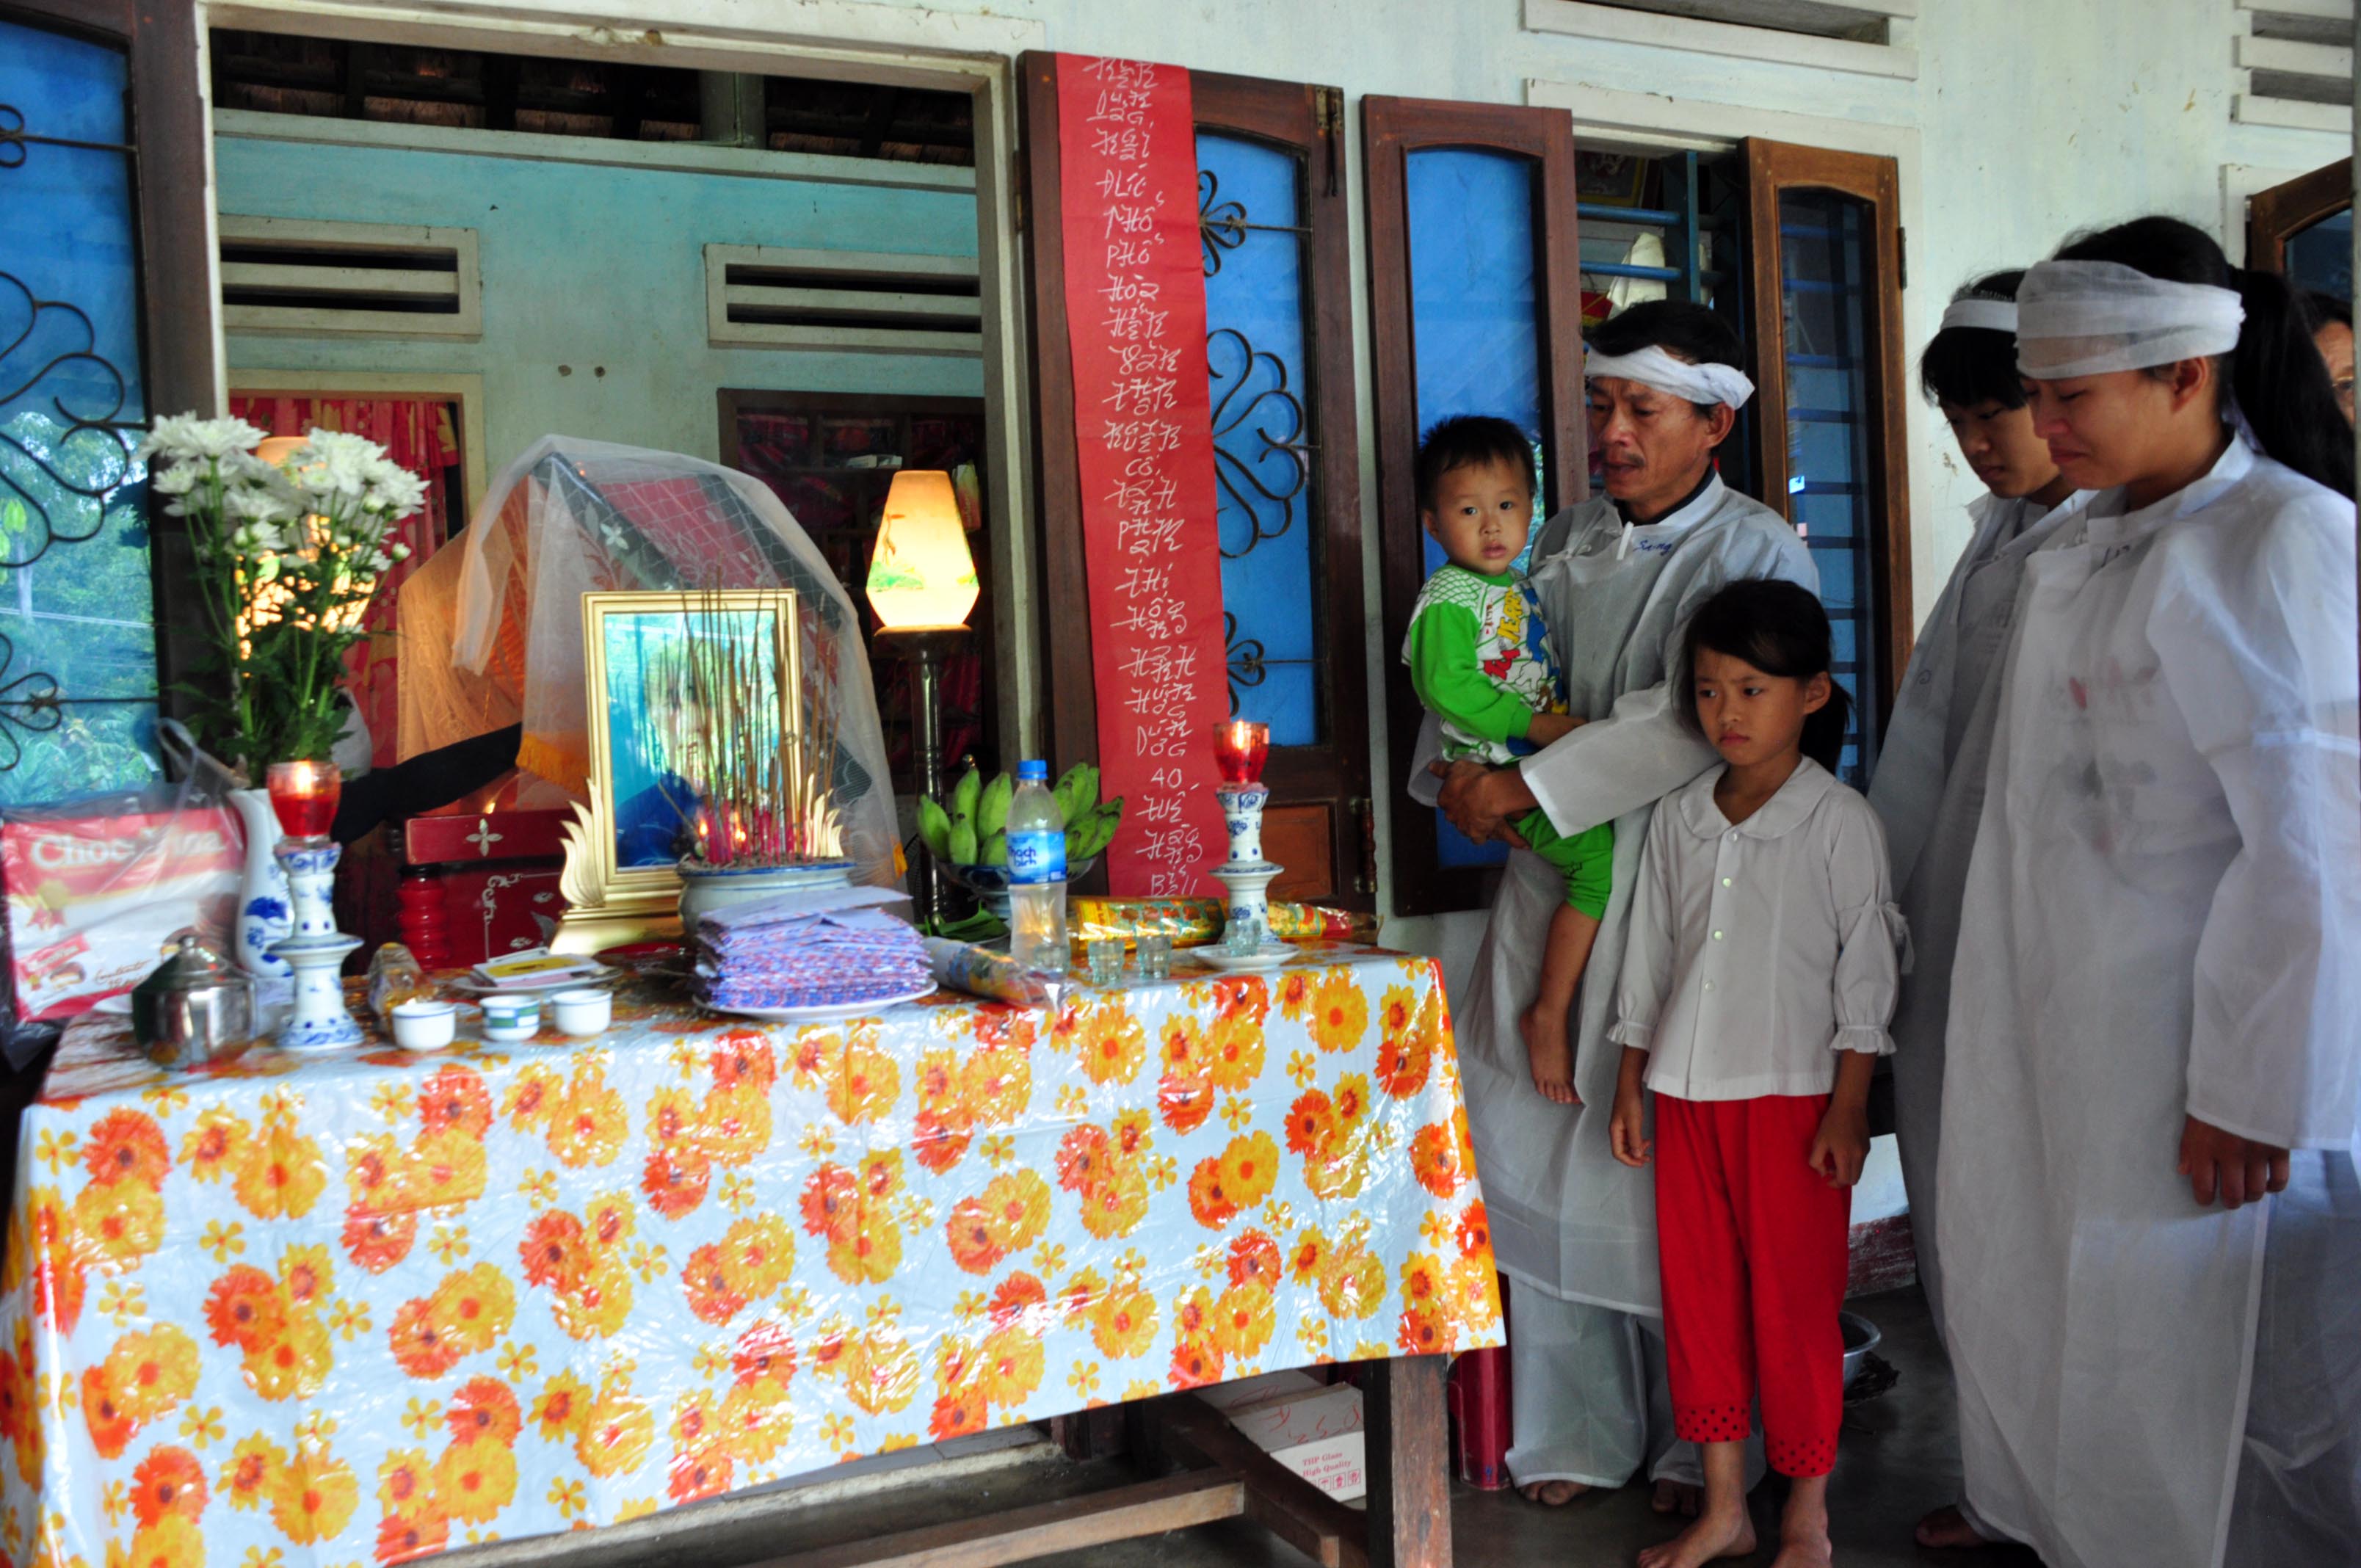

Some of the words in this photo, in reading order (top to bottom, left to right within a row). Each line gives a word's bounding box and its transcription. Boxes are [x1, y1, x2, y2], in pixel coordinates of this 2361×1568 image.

[1151, 768, 1182, 788] 40
[1304, 1467, 1321, 1477] High
[1324, 1461, 1352, 1473] Quality
